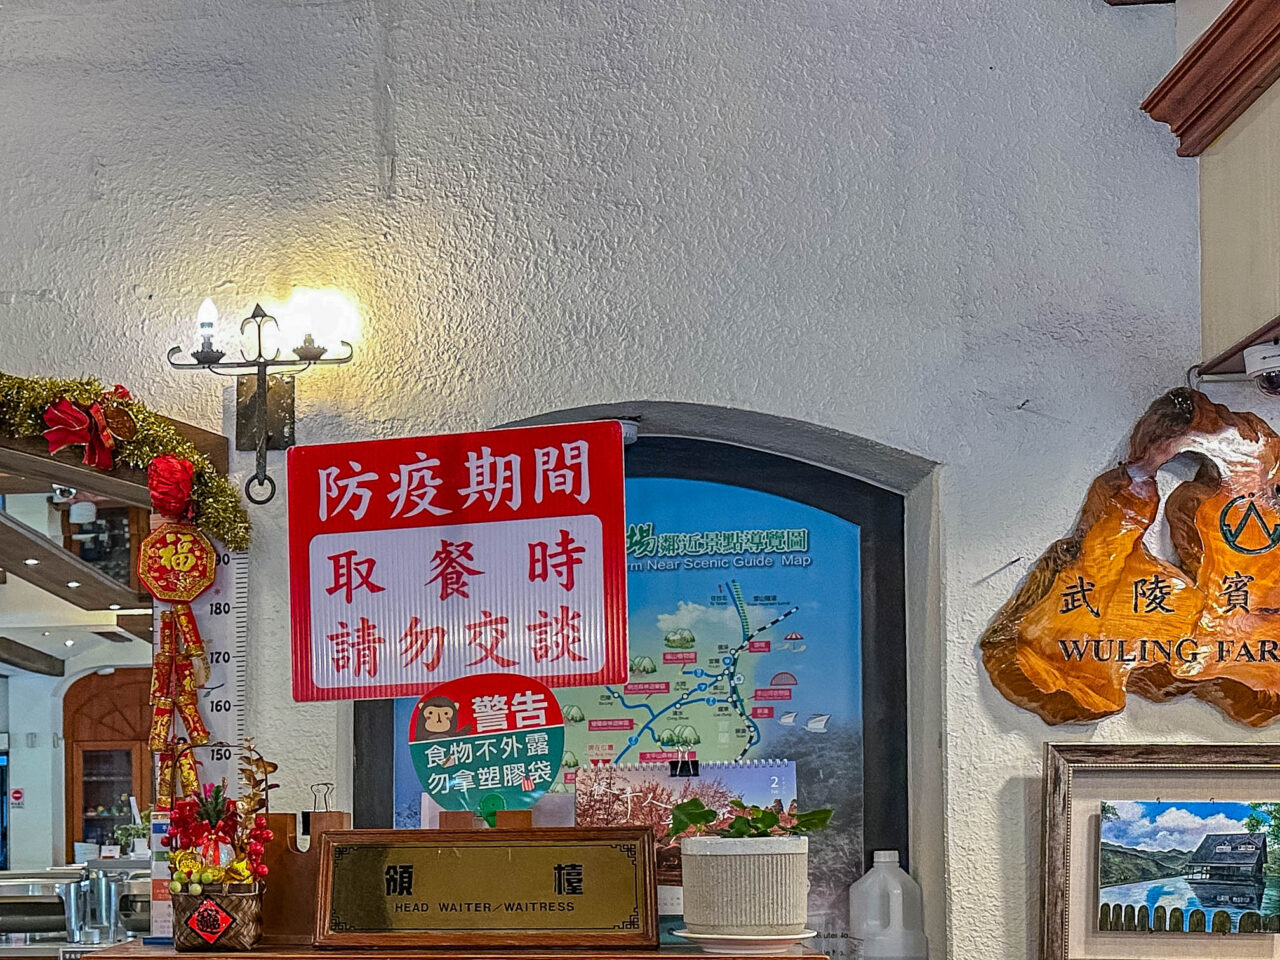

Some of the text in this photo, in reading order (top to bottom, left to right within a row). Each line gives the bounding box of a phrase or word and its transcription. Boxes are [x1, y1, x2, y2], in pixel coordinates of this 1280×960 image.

[318, 440, 591, 522] 防疫期間
[325, 529, 587, 604] 取餐時
[646, 561, 679, 571] Near
[683, 558, 729, 569] Scenic
[732, 556, 774, 568] Guide
[781, 554, 812, 567] Map
[209, 603, 231, 615] 180
[326, 605, 588, 678] 請勿交談
[1058, 638, 1198, 663] WULING
[209, 652, 231, 664] 170
[210, 700, 231, 713] 160
[471, 690, 548, 733] 警告
[210, 749, 232, 761] 150
[424, 732, 549, 769] 食物不外露
[428, 760, 553, 795] 勿拿塑膠袋
[770, 776, 779, 788] 2
[394, 902, 575, 913] HEAD WAITER/WAITRESS
